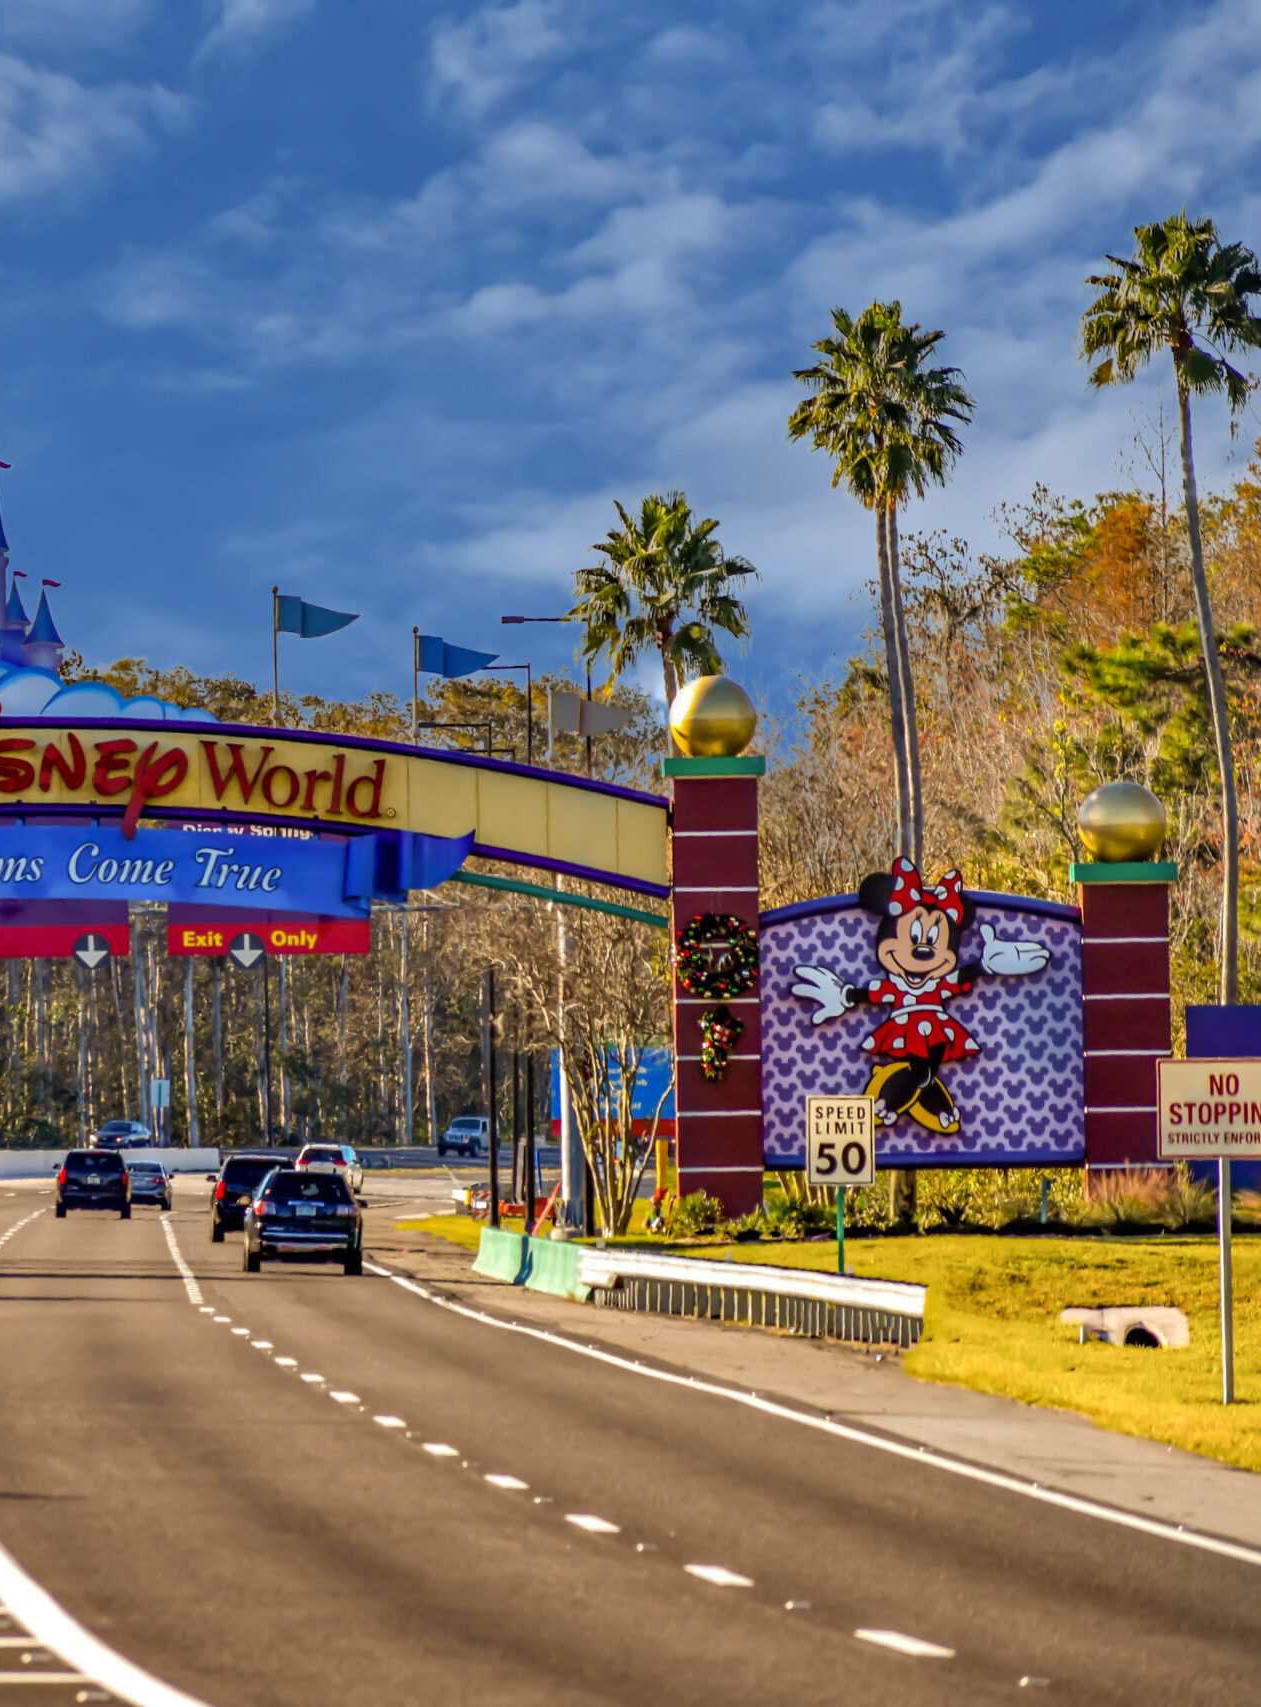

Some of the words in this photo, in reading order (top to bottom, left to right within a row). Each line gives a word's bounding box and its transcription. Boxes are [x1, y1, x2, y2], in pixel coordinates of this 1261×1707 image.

[201, 740, 386, 820] World
[67, 842, 174, 886] Come
[194, 847, 283, 892] True
[182, 931, 223, 947] Exit
[270, 930, 318, 950] Only
[1209, 1073, 1240, 1097] NO
[815, 1106, 866, 1120] SPEED
[1169, 1102, 1261, 1126] STOPPIN
[815, 1122, 866, 1135] LIMIT
[1168, 1132, 1220, 1145] STRICTLY
[815, 1141, 867, 1176] 50
